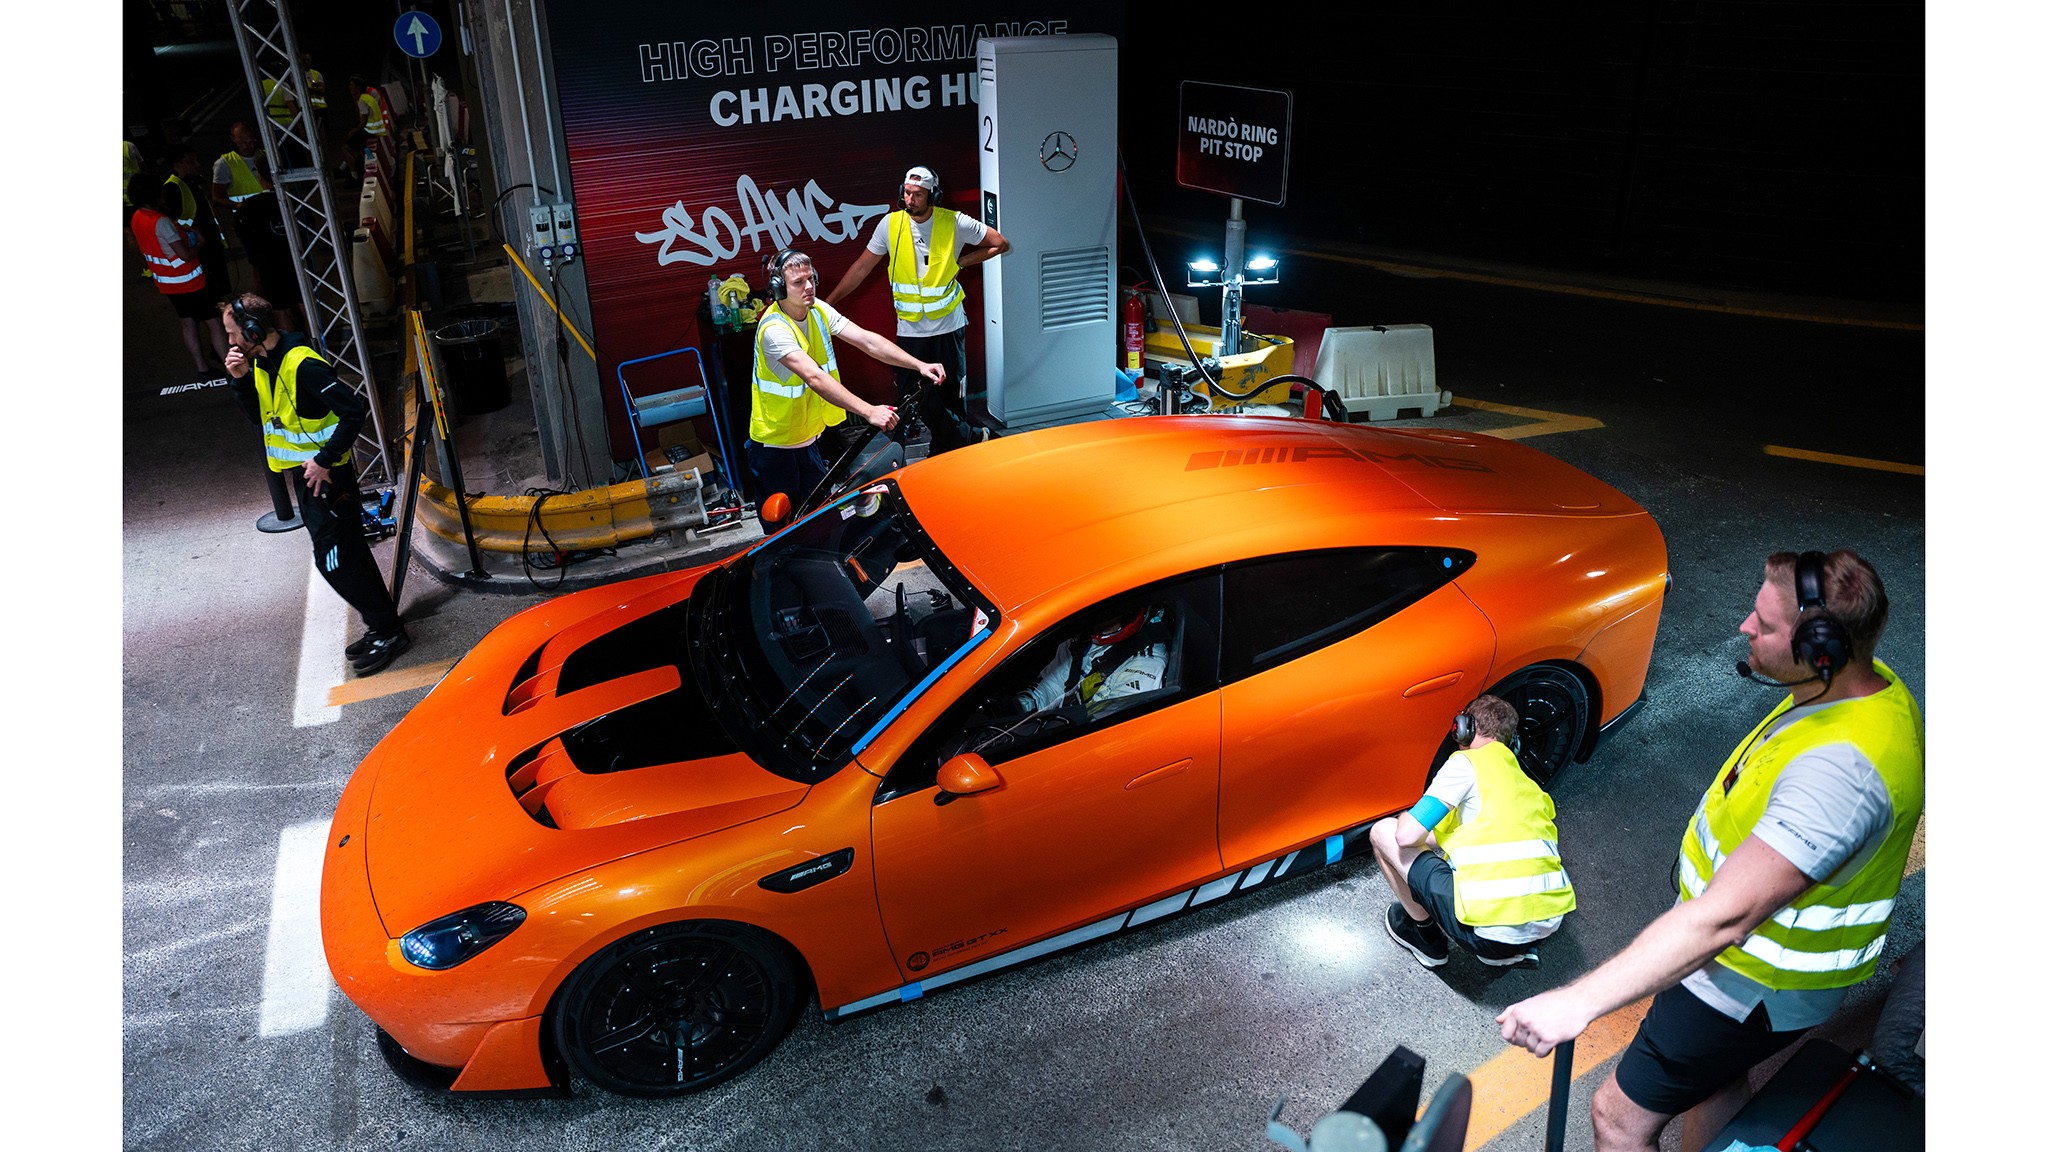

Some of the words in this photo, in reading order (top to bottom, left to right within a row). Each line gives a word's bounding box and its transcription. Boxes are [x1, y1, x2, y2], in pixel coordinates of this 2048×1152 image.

[639, 37, 754, 83] HIGH
[709, 75, 931, 127] CHARGING
[983, 115, 994, 153] 2
[1188, 116, 1239, 139] NARDÒ
[1241, 123, 1278, 145] RING
[1200, 137, 1223, 156] PIT
[1224, 141, 1263, 163] STOP
[182, 377, 228, 392] AMG
[1291, 446, 1498, 474] AMG
[1133, 668, 1157, 681] AMG
[1789, 827, 1818, 851] AMG
[932, 941, 965, 958] AMG
[966, 933, 988, 946] GT
[988, 926, 1009, 938] XX
